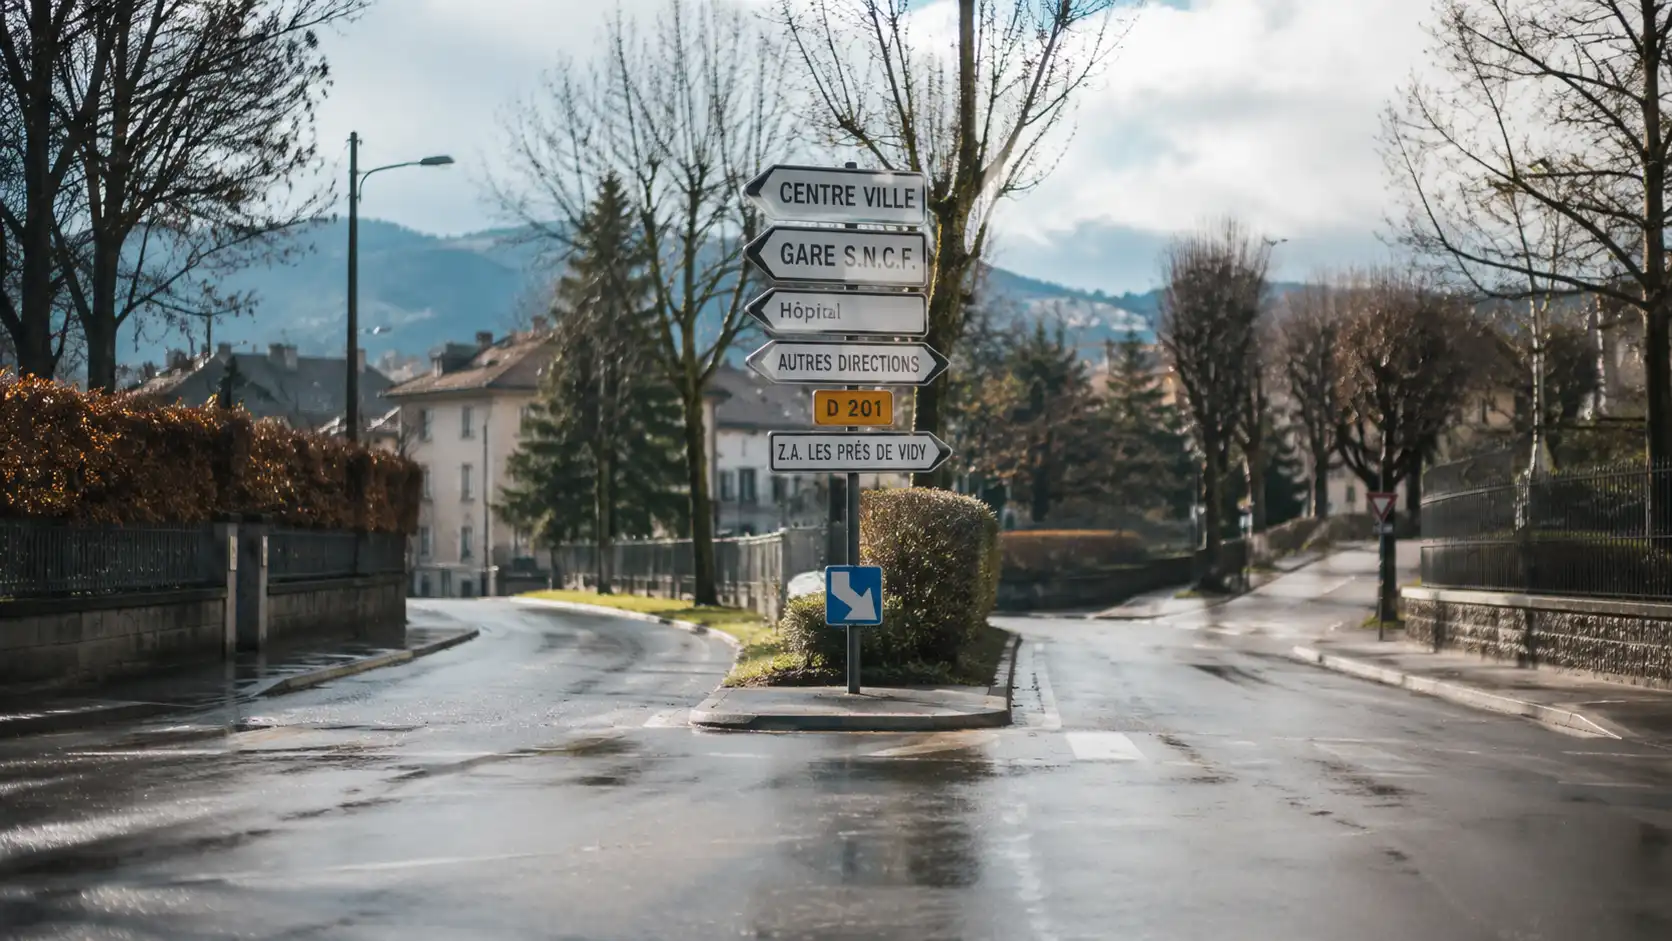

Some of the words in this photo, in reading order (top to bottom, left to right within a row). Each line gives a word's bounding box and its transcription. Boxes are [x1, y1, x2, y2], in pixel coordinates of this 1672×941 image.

[779, 181, 856, 207] CENTRE
[863, 186, 916, 209] VILLE
[780, 242, 836, 267] GARE
[844, 245, 916, 270] S.N.C.F.
[778, 353, 832, 372] AUTRES
[838, 354, 920, 373] DIRECTIONS
[827, 399, 839, 417] D
[848, 399, 881, 417] 201
[778, 443, 802, 461] Z.A.
[808, 444, 832, 461] LES
[837, 440, 870, 461] PRÉS
[876, 444, 893, 461] DE
[898, 444, 926, 461] VIDY
